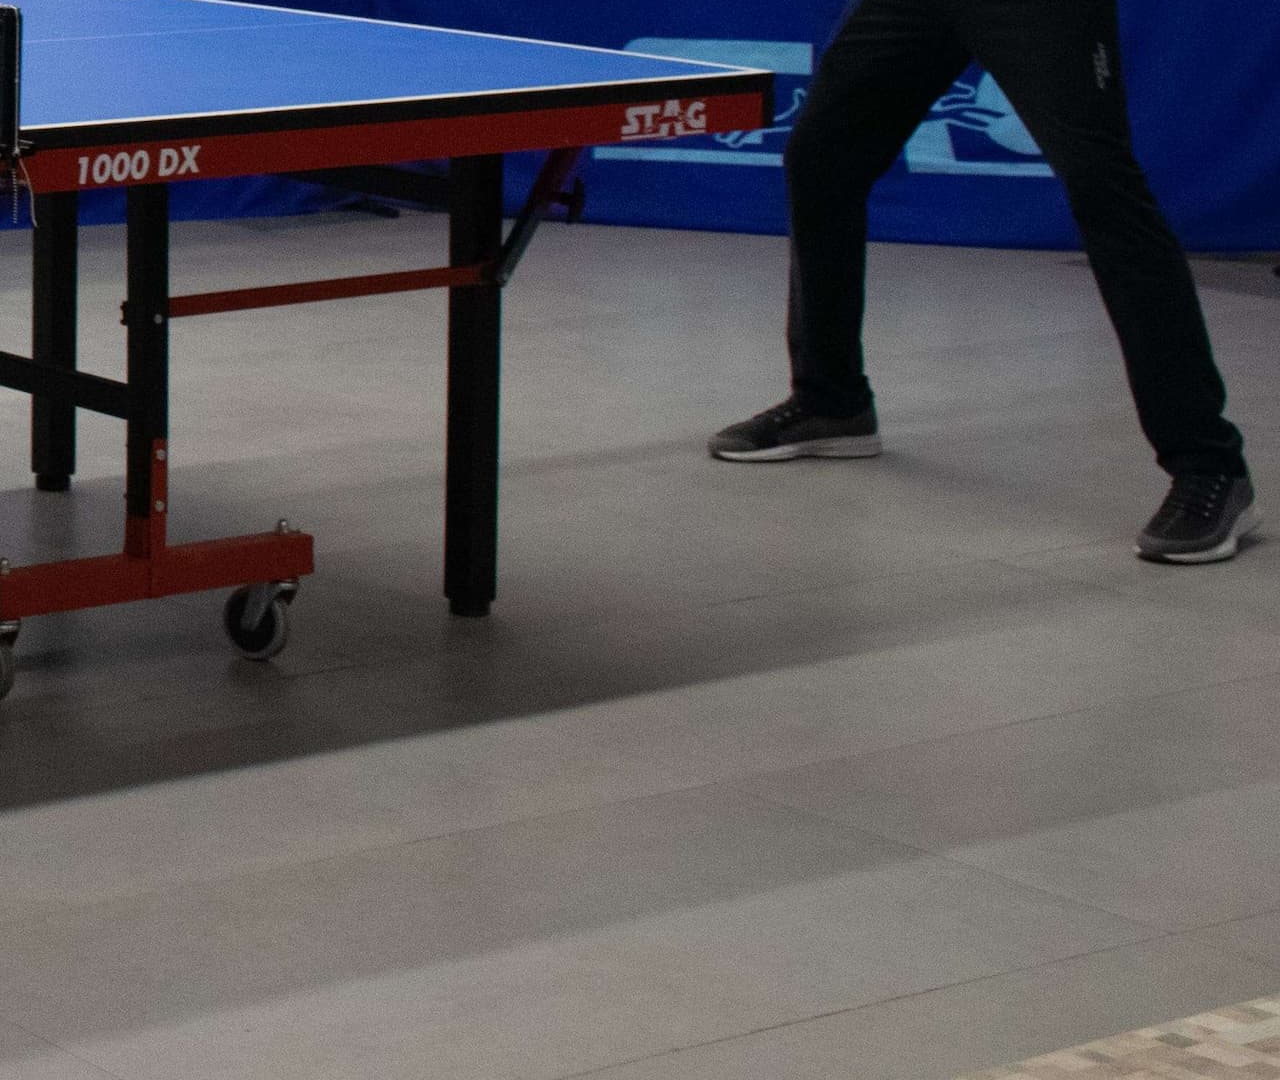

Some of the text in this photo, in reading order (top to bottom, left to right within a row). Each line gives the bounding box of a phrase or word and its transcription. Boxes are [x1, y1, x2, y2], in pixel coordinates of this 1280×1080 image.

[621, 99, 707, 140] STAG
[78, 144, 201, 185] 1000 DX
